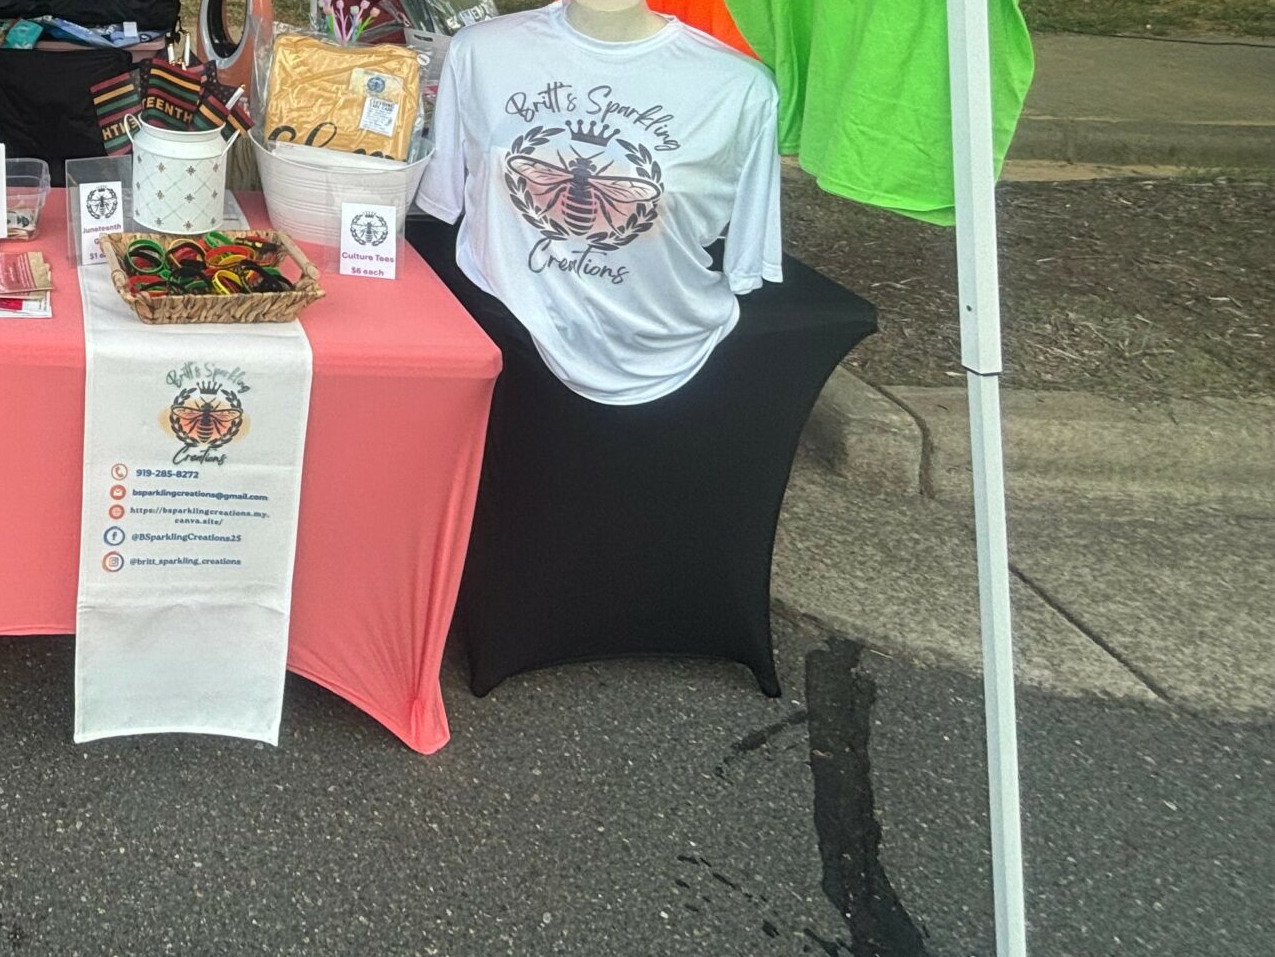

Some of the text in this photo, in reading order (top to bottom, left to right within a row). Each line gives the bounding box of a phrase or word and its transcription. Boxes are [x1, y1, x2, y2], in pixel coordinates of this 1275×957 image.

[504, 81, 681, 151] Britt's Sparkling
[83, 224, 122, 234] Juneteenth
[341, 251, 395, 263] Culture Tees
[528, 238, 630, 284] Creations
[205, 362, 251, 394] Sparkling
[172, 445, 227, 466] Creations
[136, 469, 199, 478] 919-285-8272
[132, 489, 268, 501] bsparklingcreations@gmail.com
[129, 507, 270, 519] https://bsparklingcreations.my.
[174, 518, 223, 526] canva.site/
[131, 533, 242, 542] @BSparklingCreations25
[129, 557, 242, 566] @britt_sparkling_creations
